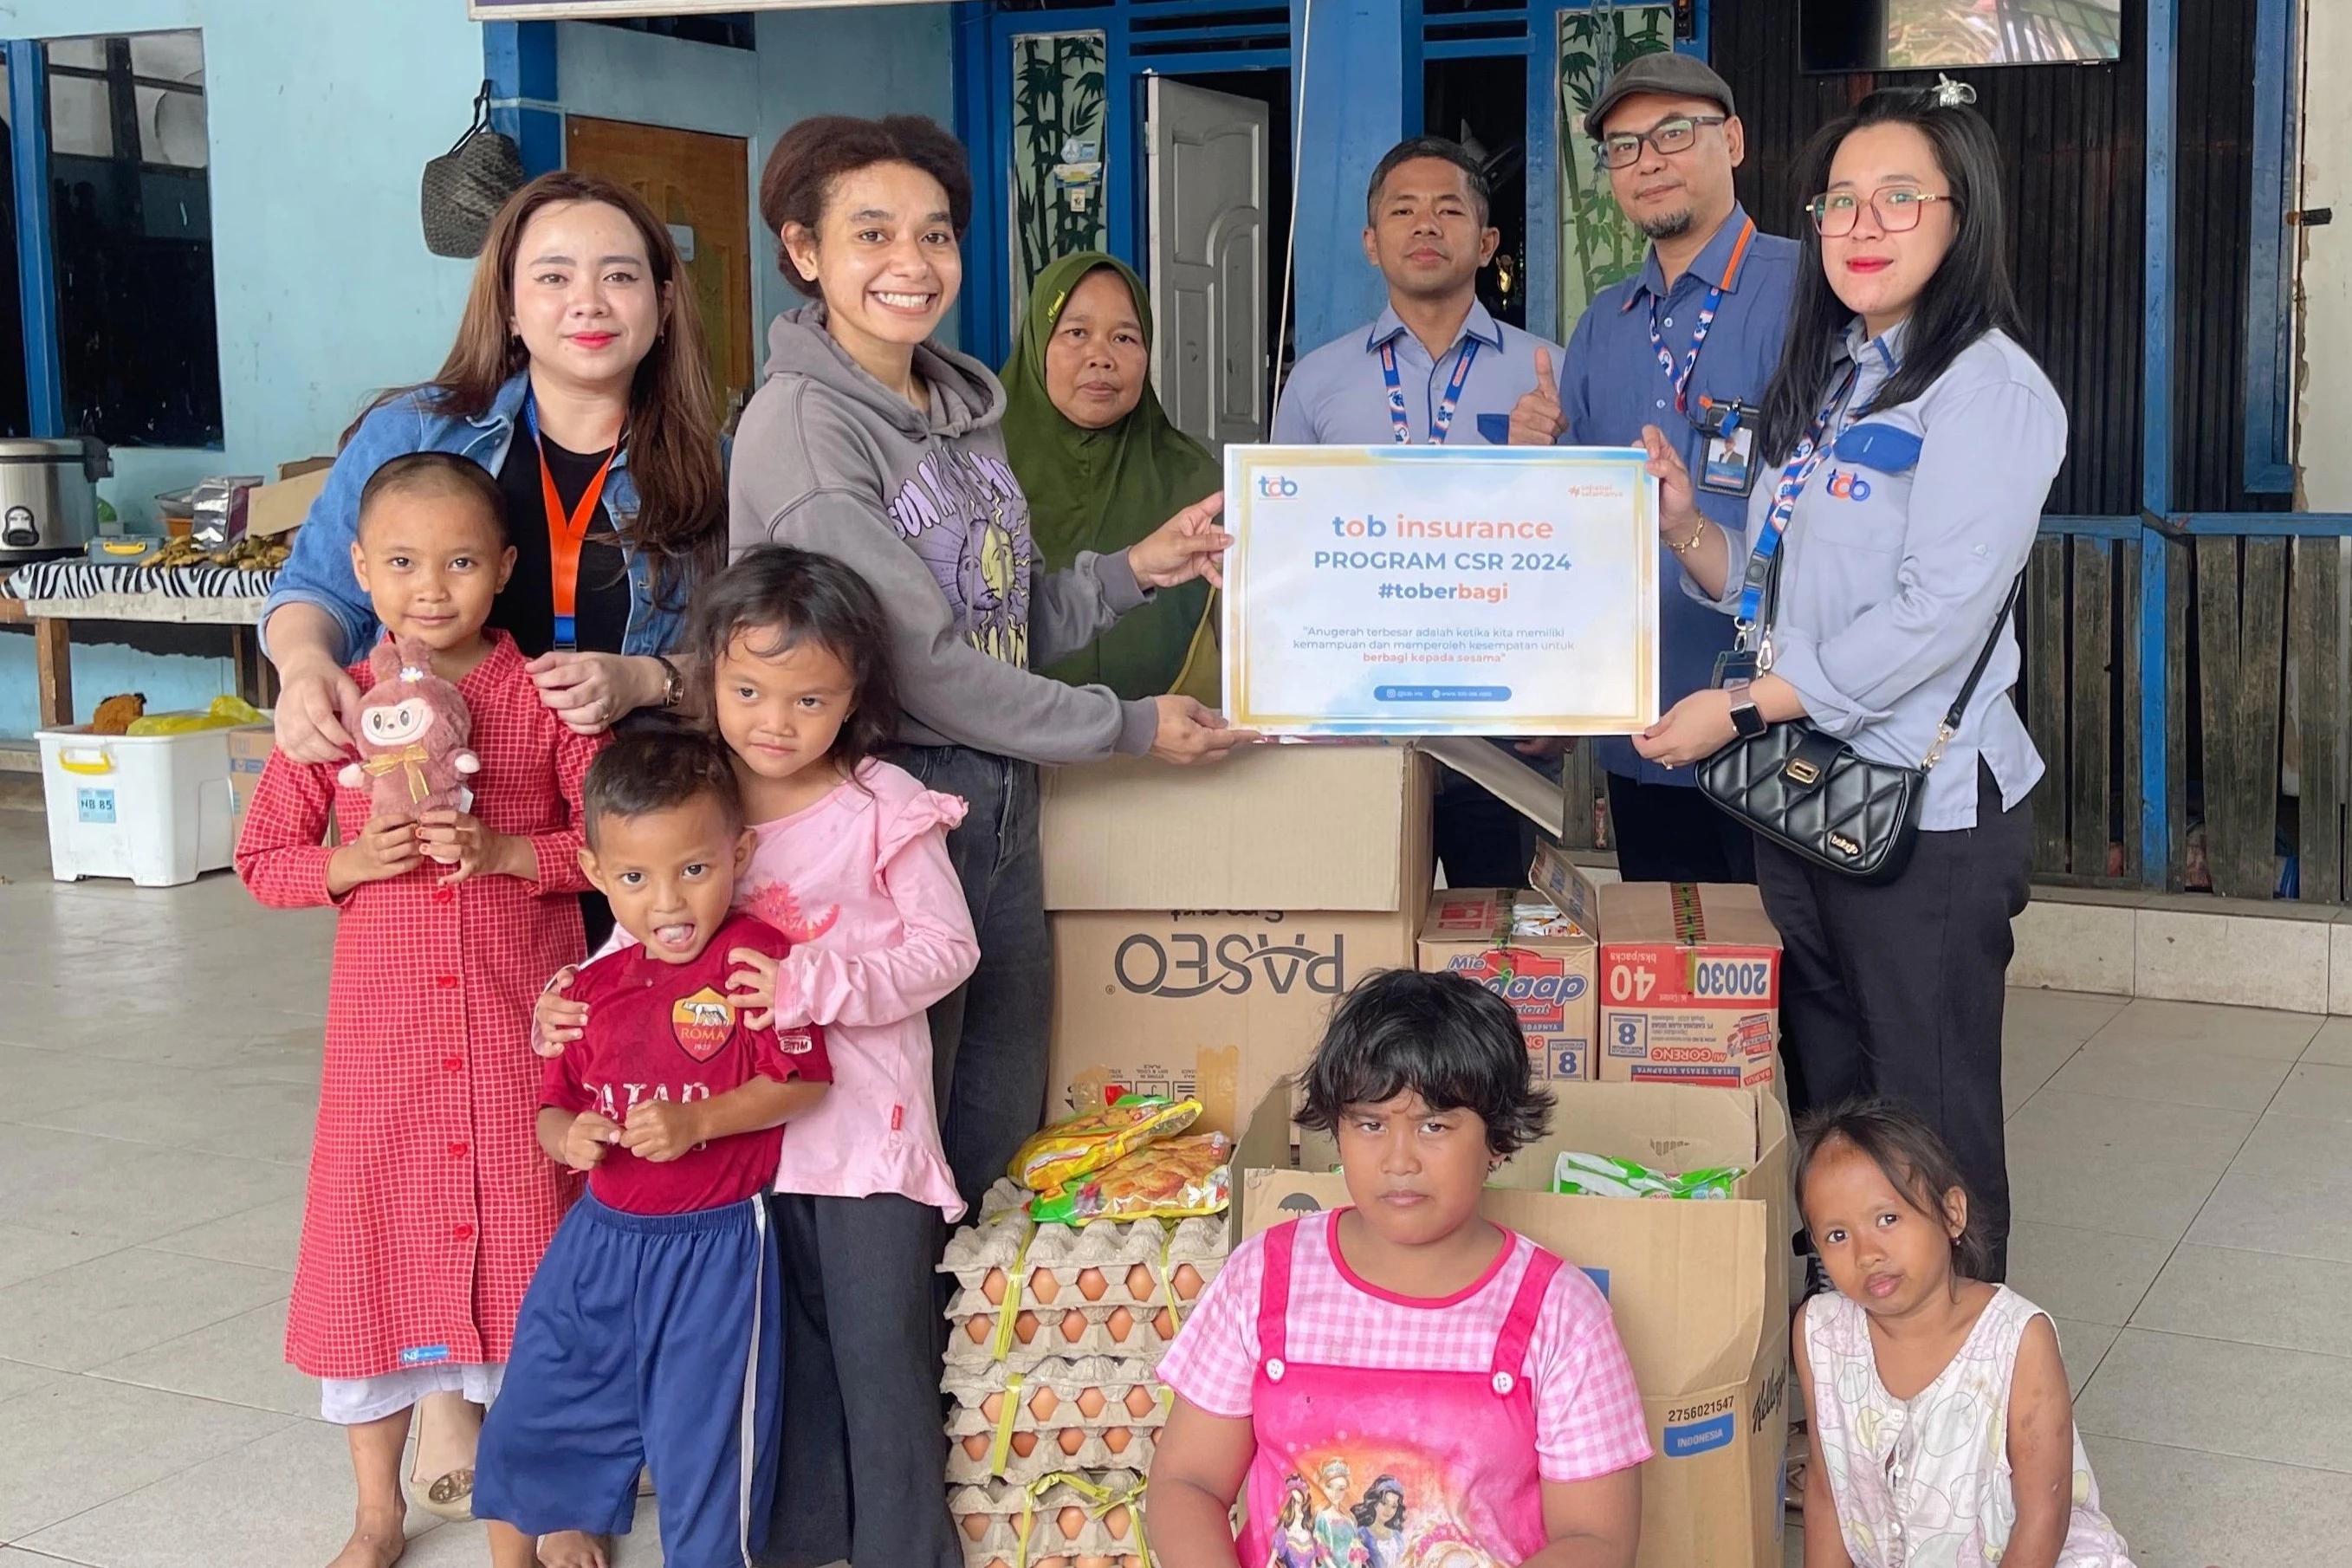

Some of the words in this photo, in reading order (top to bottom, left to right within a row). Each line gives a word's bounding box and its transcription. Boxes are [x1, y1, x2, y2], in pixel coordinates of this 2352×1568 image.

[1258, 476, 1298, 496] tob
[1826, 468, 1871, 502] tob
[1332, 515, 1387, 537] tob
[1396, 514, 1553, 539] insurance
[1314, 551, 1446, 570] PROGRAM
[1454, 553, 1504, 570] CSR
[1511, 553, 1572, 571] 2024
[1377, 582, 1509, 604] #toberbagi
[1366, 627, 1413, 638] terbesar
[1416, 627, 1454, 638] adalah
[1456, 627, 1490, 638] ketika
[1493, 627, 1513, 638] kita
[1516, 627, 1565, 638] memiliki
[1293, 639, 1366, 651] kemampuan
[1369, 639, 1390, 650] dan
[1393, 640, 1467, 651] memperoleh
[1469, 640, 1539, 651] kesempatan
[1540, 641, 1575, 651] untuk
[1363, 652, 1408, 664] berbagi
[1410, 652, 1455, 664] kepada
[99, 800, 113, 811] 85
[1114, 933, 1344, 999] PASEO
[1448, 955, 1487, 971] Mie
[1610, 952, 1656, 964] bks/packs
[1464, 967, 1589, 1008] daap
[1610, 964, 1656, 1001] 40
[1696, 962, 1767, 995] 20030
[681, 1027, 726, 1040] ROMA
[1618, 1022, 1636, 1045] 8
[1559, 1052, 1577, 1074] 8
[1651, 1046, 1713, 1062] GORENG
[1668, 1395, 1734, 1422] 2756021547
[1677, 1428, 1724, 1448] INDONESIA
